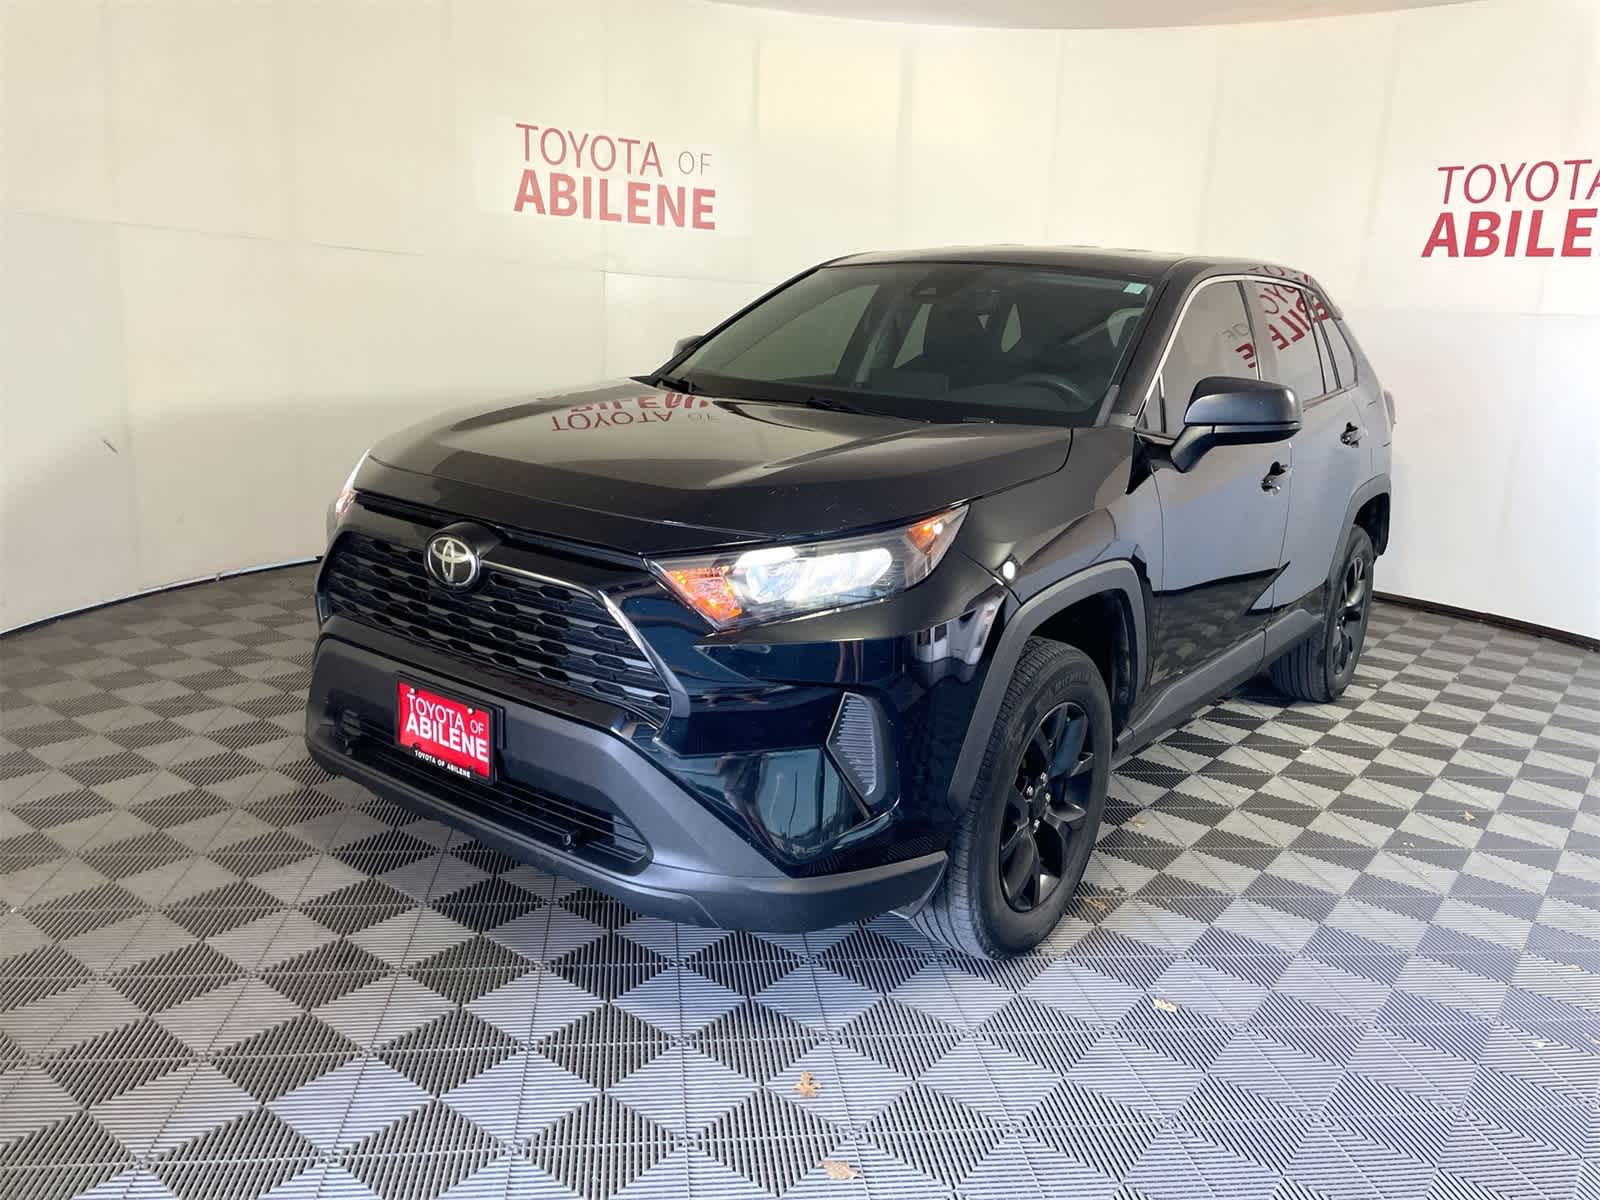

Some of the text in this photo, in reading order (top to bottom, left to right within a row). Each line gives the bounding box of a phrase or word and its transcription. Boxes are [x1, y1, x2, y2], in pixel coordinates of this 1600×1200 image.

[515, 123, 713, 178] TOYOTA OF
[513, 168, 716, 231] ABILENE
[1420, 208, 1600, 258] ABILE
[406, 694, 484, 734] TOYOTA OF
[406, 712, 489, 763] ABILENE
[414, 749, 471, 778] TOYOTA OF ABILENE
